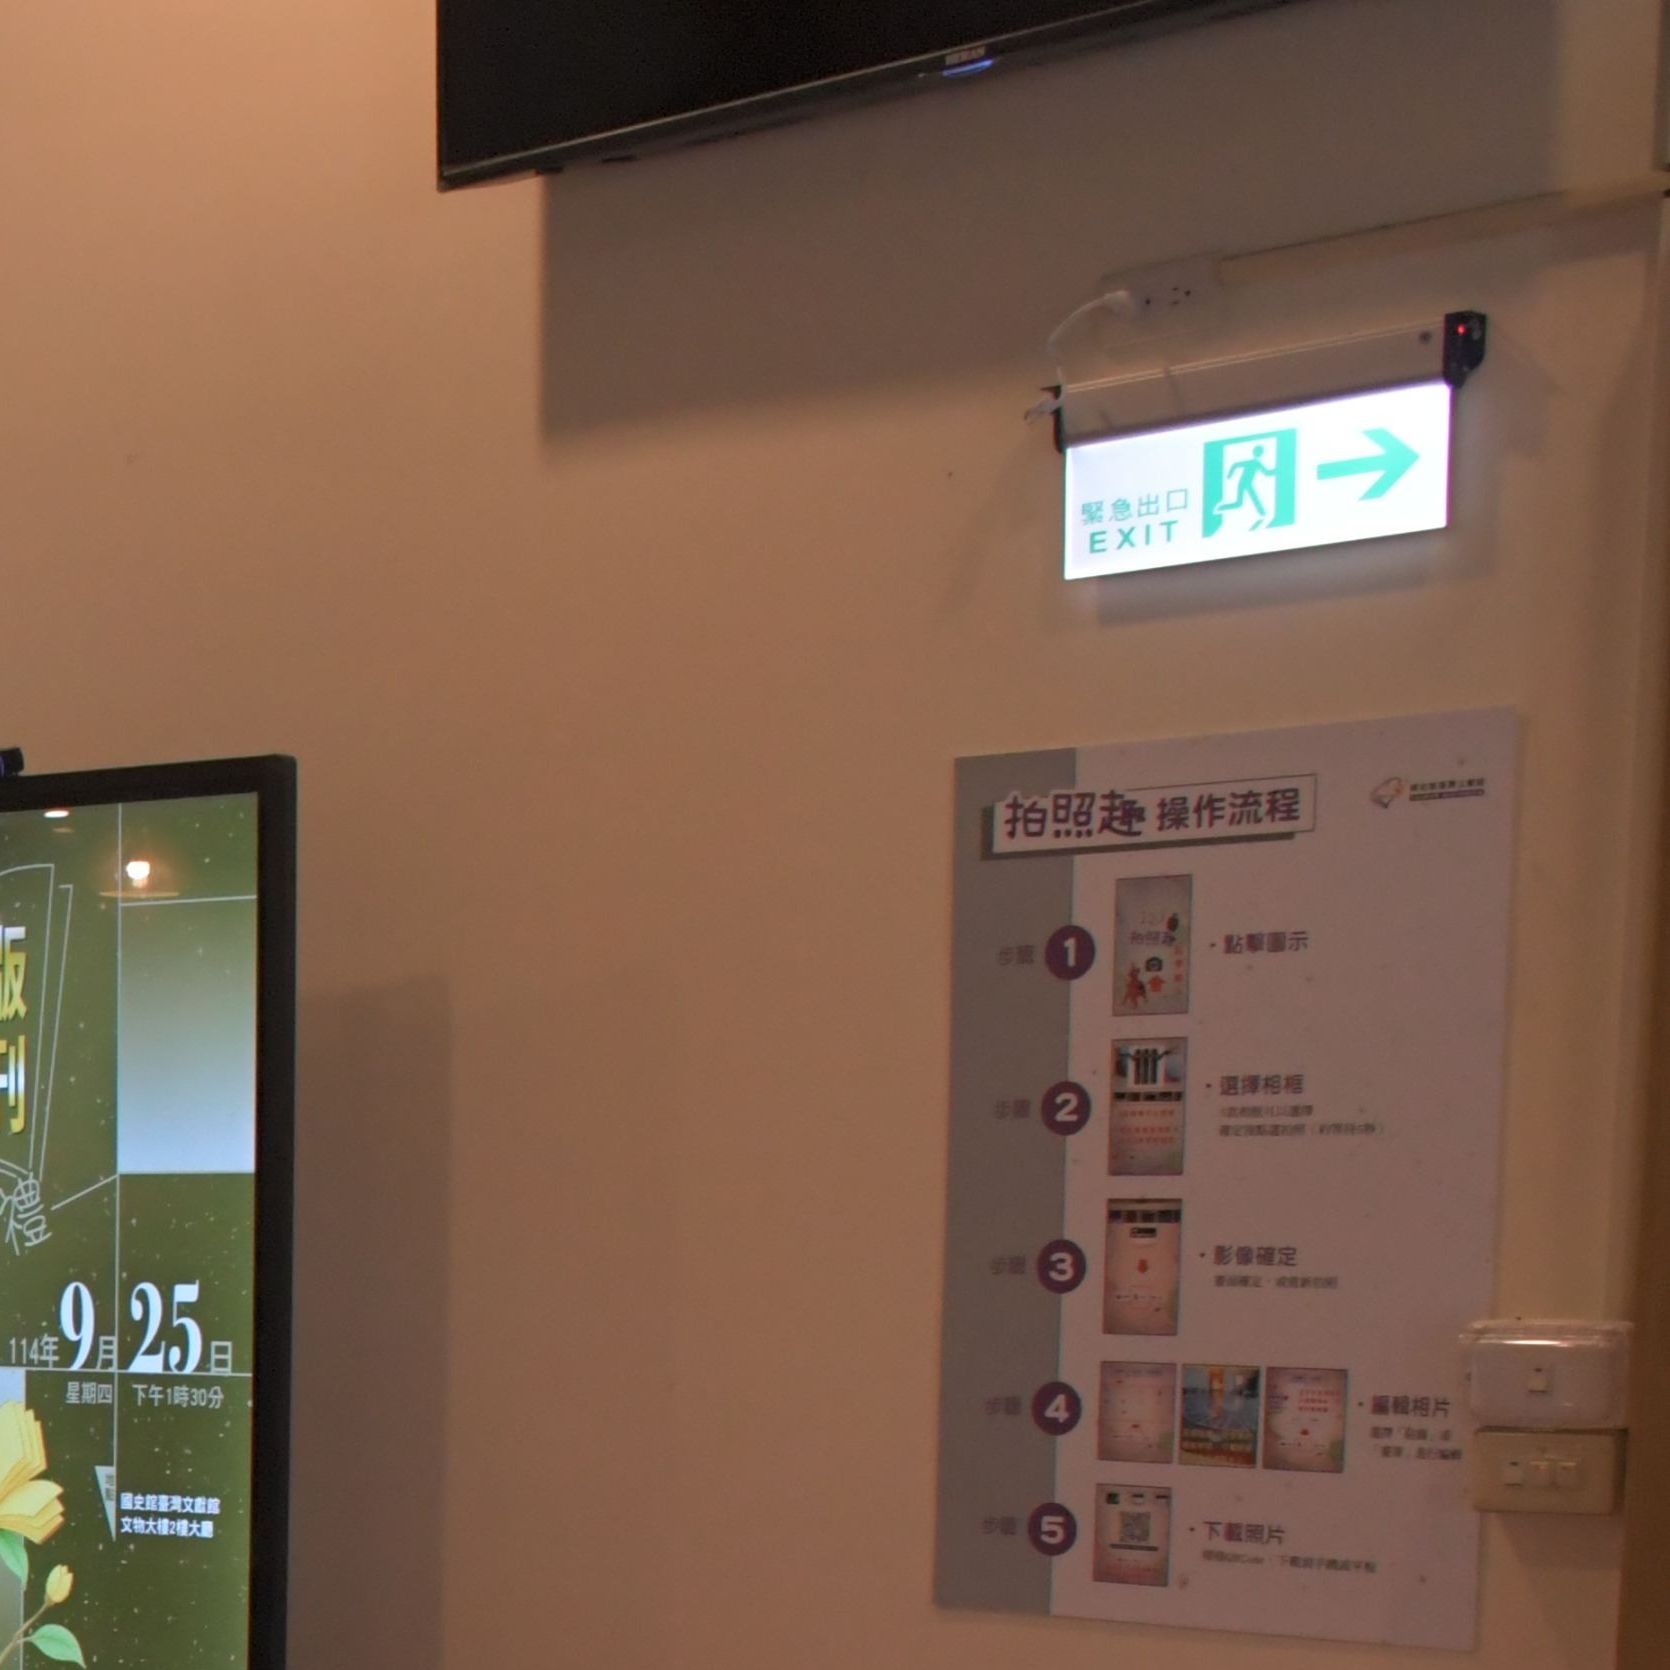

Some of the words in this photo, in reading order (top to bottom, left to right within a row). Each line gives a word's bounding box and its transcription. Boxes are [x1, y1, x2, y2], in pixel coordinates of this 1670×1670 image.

[1081, 487, 1189, 524] 緊急出口
[1088, 519, 1180, 554] EXIT
[1004, 789, 1147, 841] 拍照趣
[1156, 786, 1301, 831] 操作流程
[1055, 1093, 1079, 1122] 2
[1050, 1253, 1073, 1281] 3
[65, 1381, 114, 1405] 星期四
[132, 1383, 225, 1410] 下午1時30分
[1045, 1395, 1071, 1422] 4
[1041, 1516, 1065, 1544] 5
